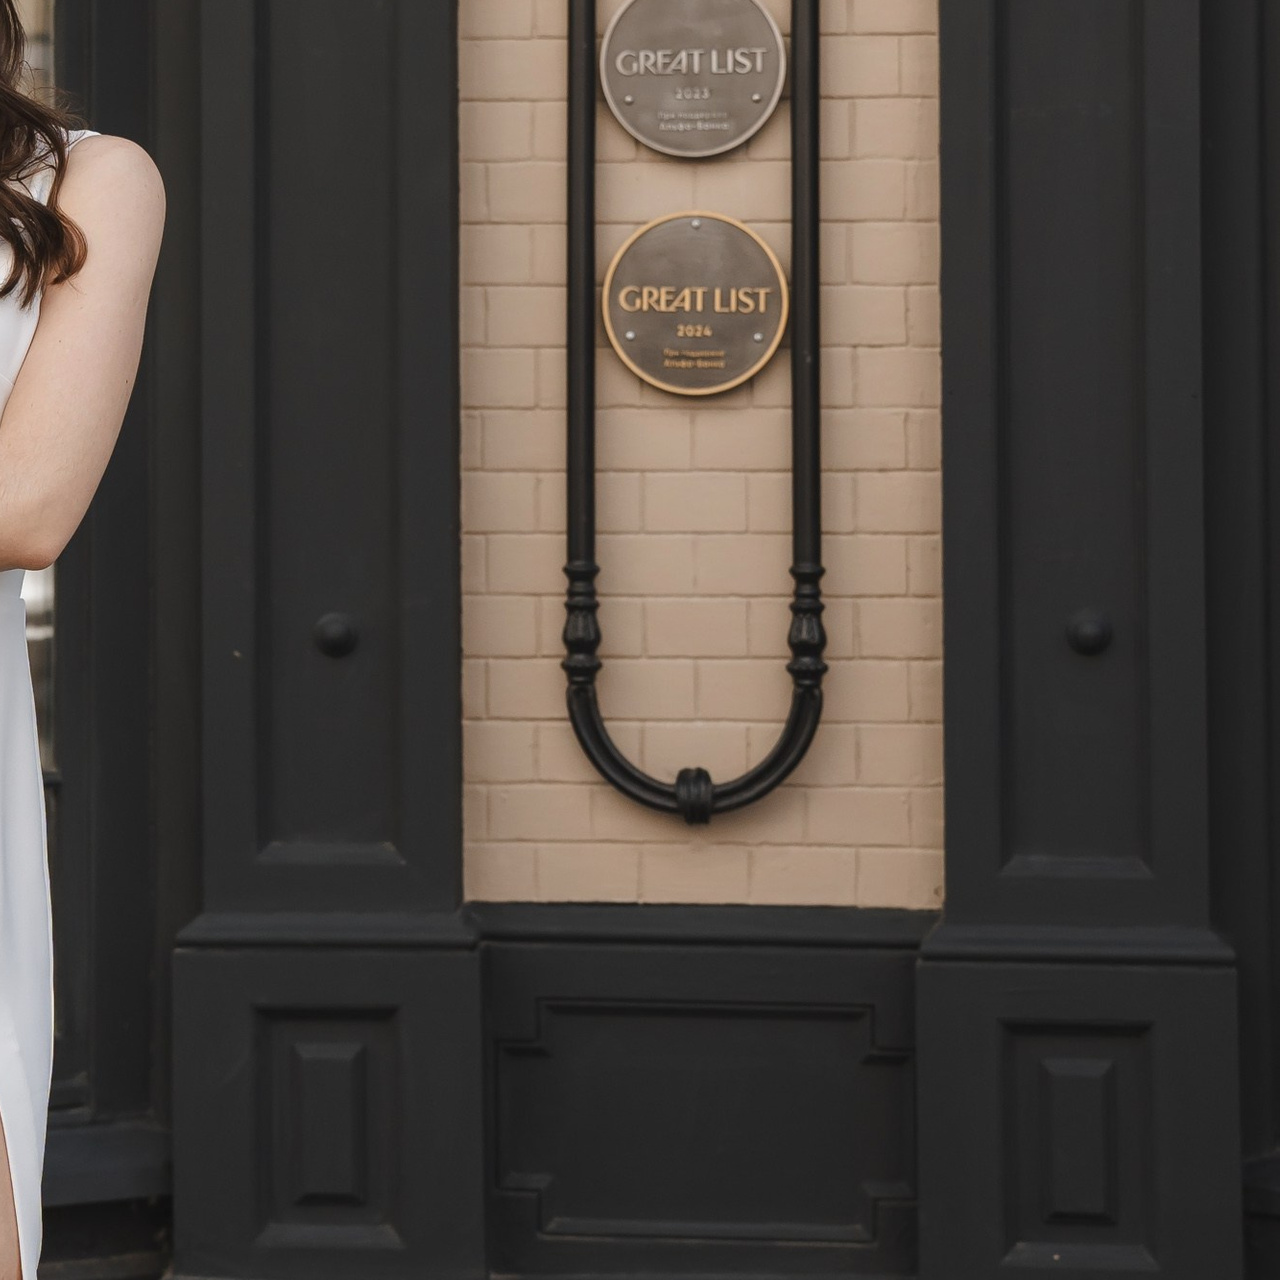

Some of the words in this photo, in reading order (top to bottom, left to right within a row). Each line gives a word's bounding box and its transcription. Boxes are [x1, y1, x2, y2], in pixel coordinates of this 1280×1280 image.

[615, 49, 704, 76] GREAT
[711, 47, 767, 74] LIST
[619, 285, 707, 312] GREAT
[714, 287, 772, 314] LIST
[676, 324, 713, 337] 2024
